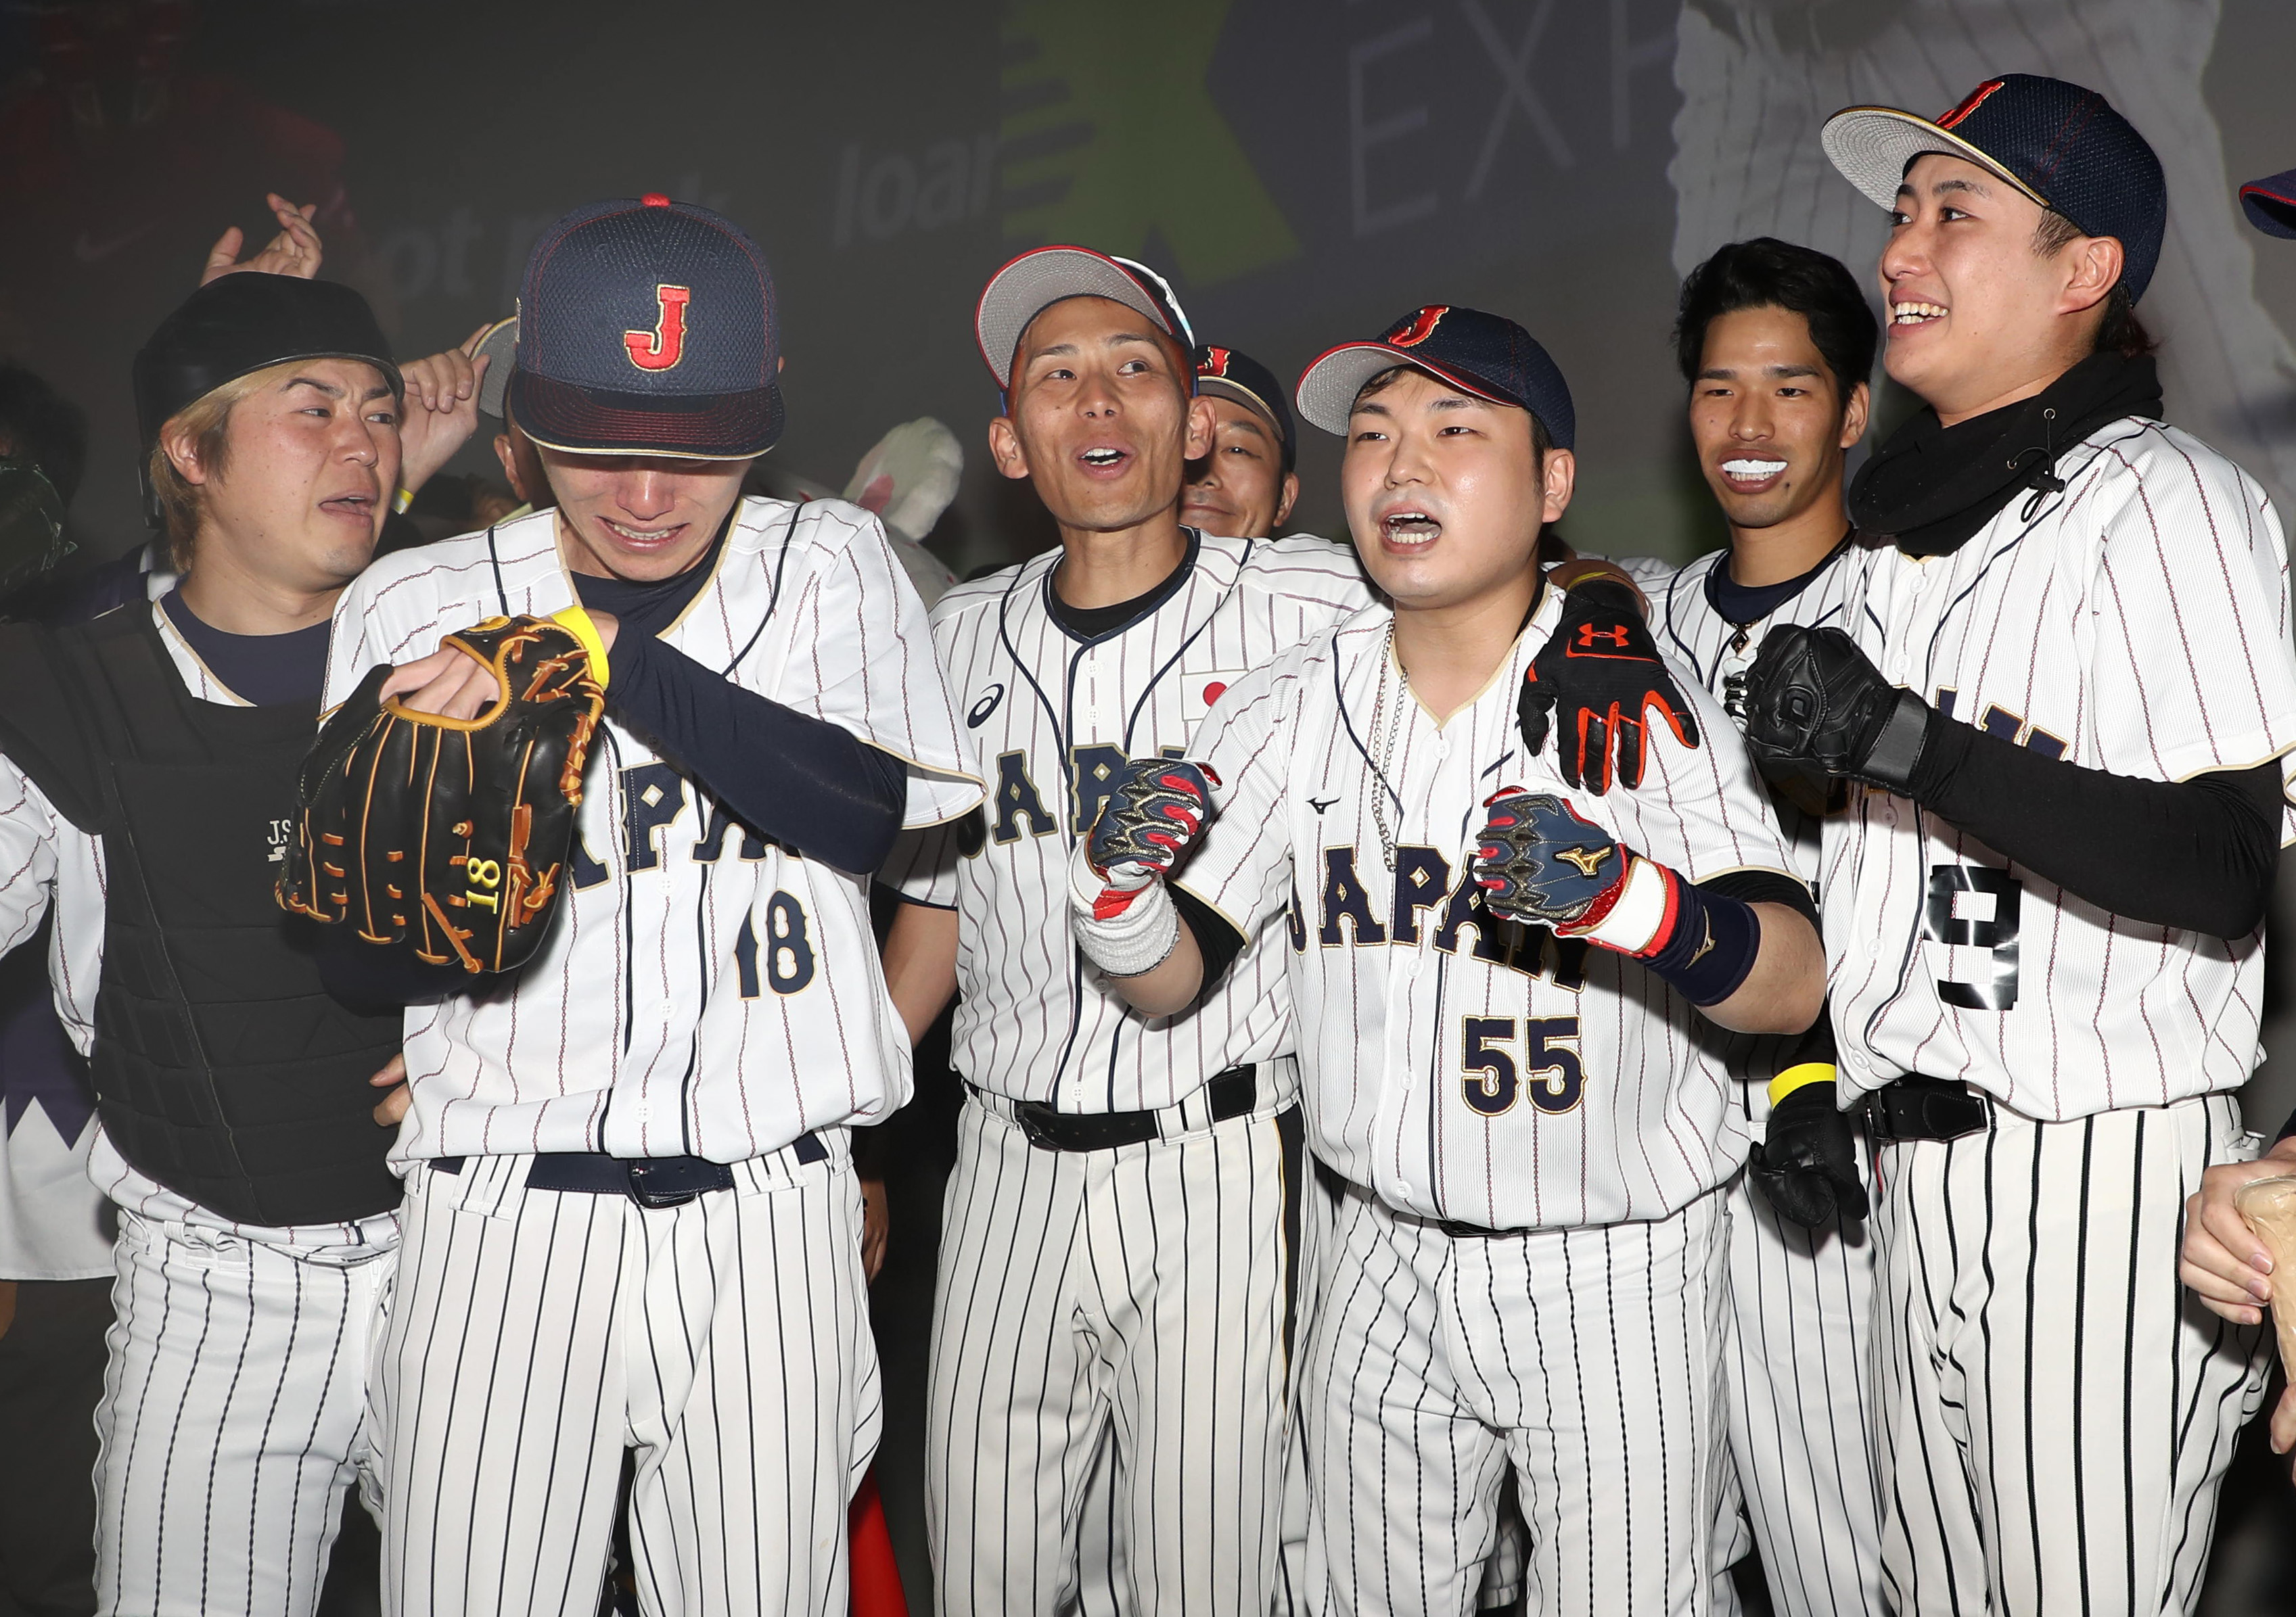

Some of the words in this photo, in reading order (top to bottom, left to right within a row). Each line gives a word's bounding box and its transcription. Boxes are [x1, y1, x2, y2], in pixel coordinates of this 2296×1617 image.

[624, 284, 690, 372] J
[1387, 304, 1450, 348] J
[465, 857, 501, 914] 18
[734, 888, 817, 1000] 18
[1923, 865, 2023, 1011] 9
[1461, 1014, 1588, 1117] 55
